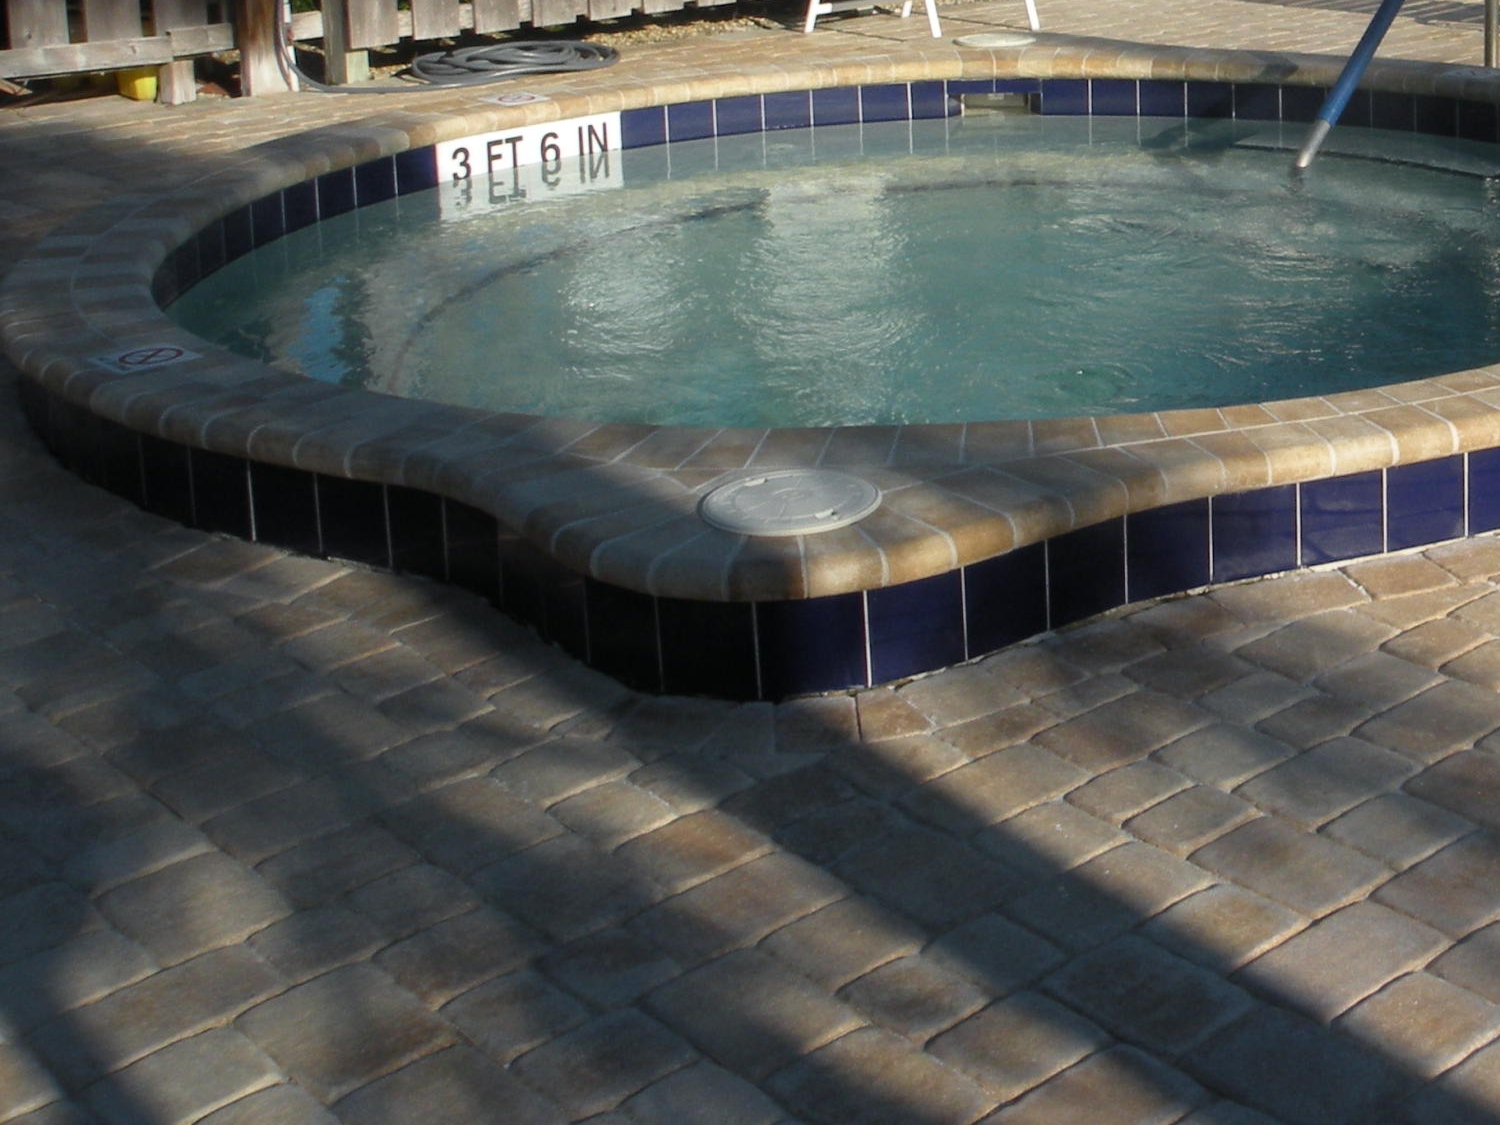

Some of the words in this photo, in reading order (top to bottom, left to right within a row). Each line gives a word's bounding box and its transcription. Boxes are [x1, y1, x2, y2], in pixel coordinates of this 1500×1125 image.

[452, 147, 472, 180] 3
[487, 135, 523, 174] FT
[540, 132, 561, 163] 6
[578, 122, 608, 156] IN
